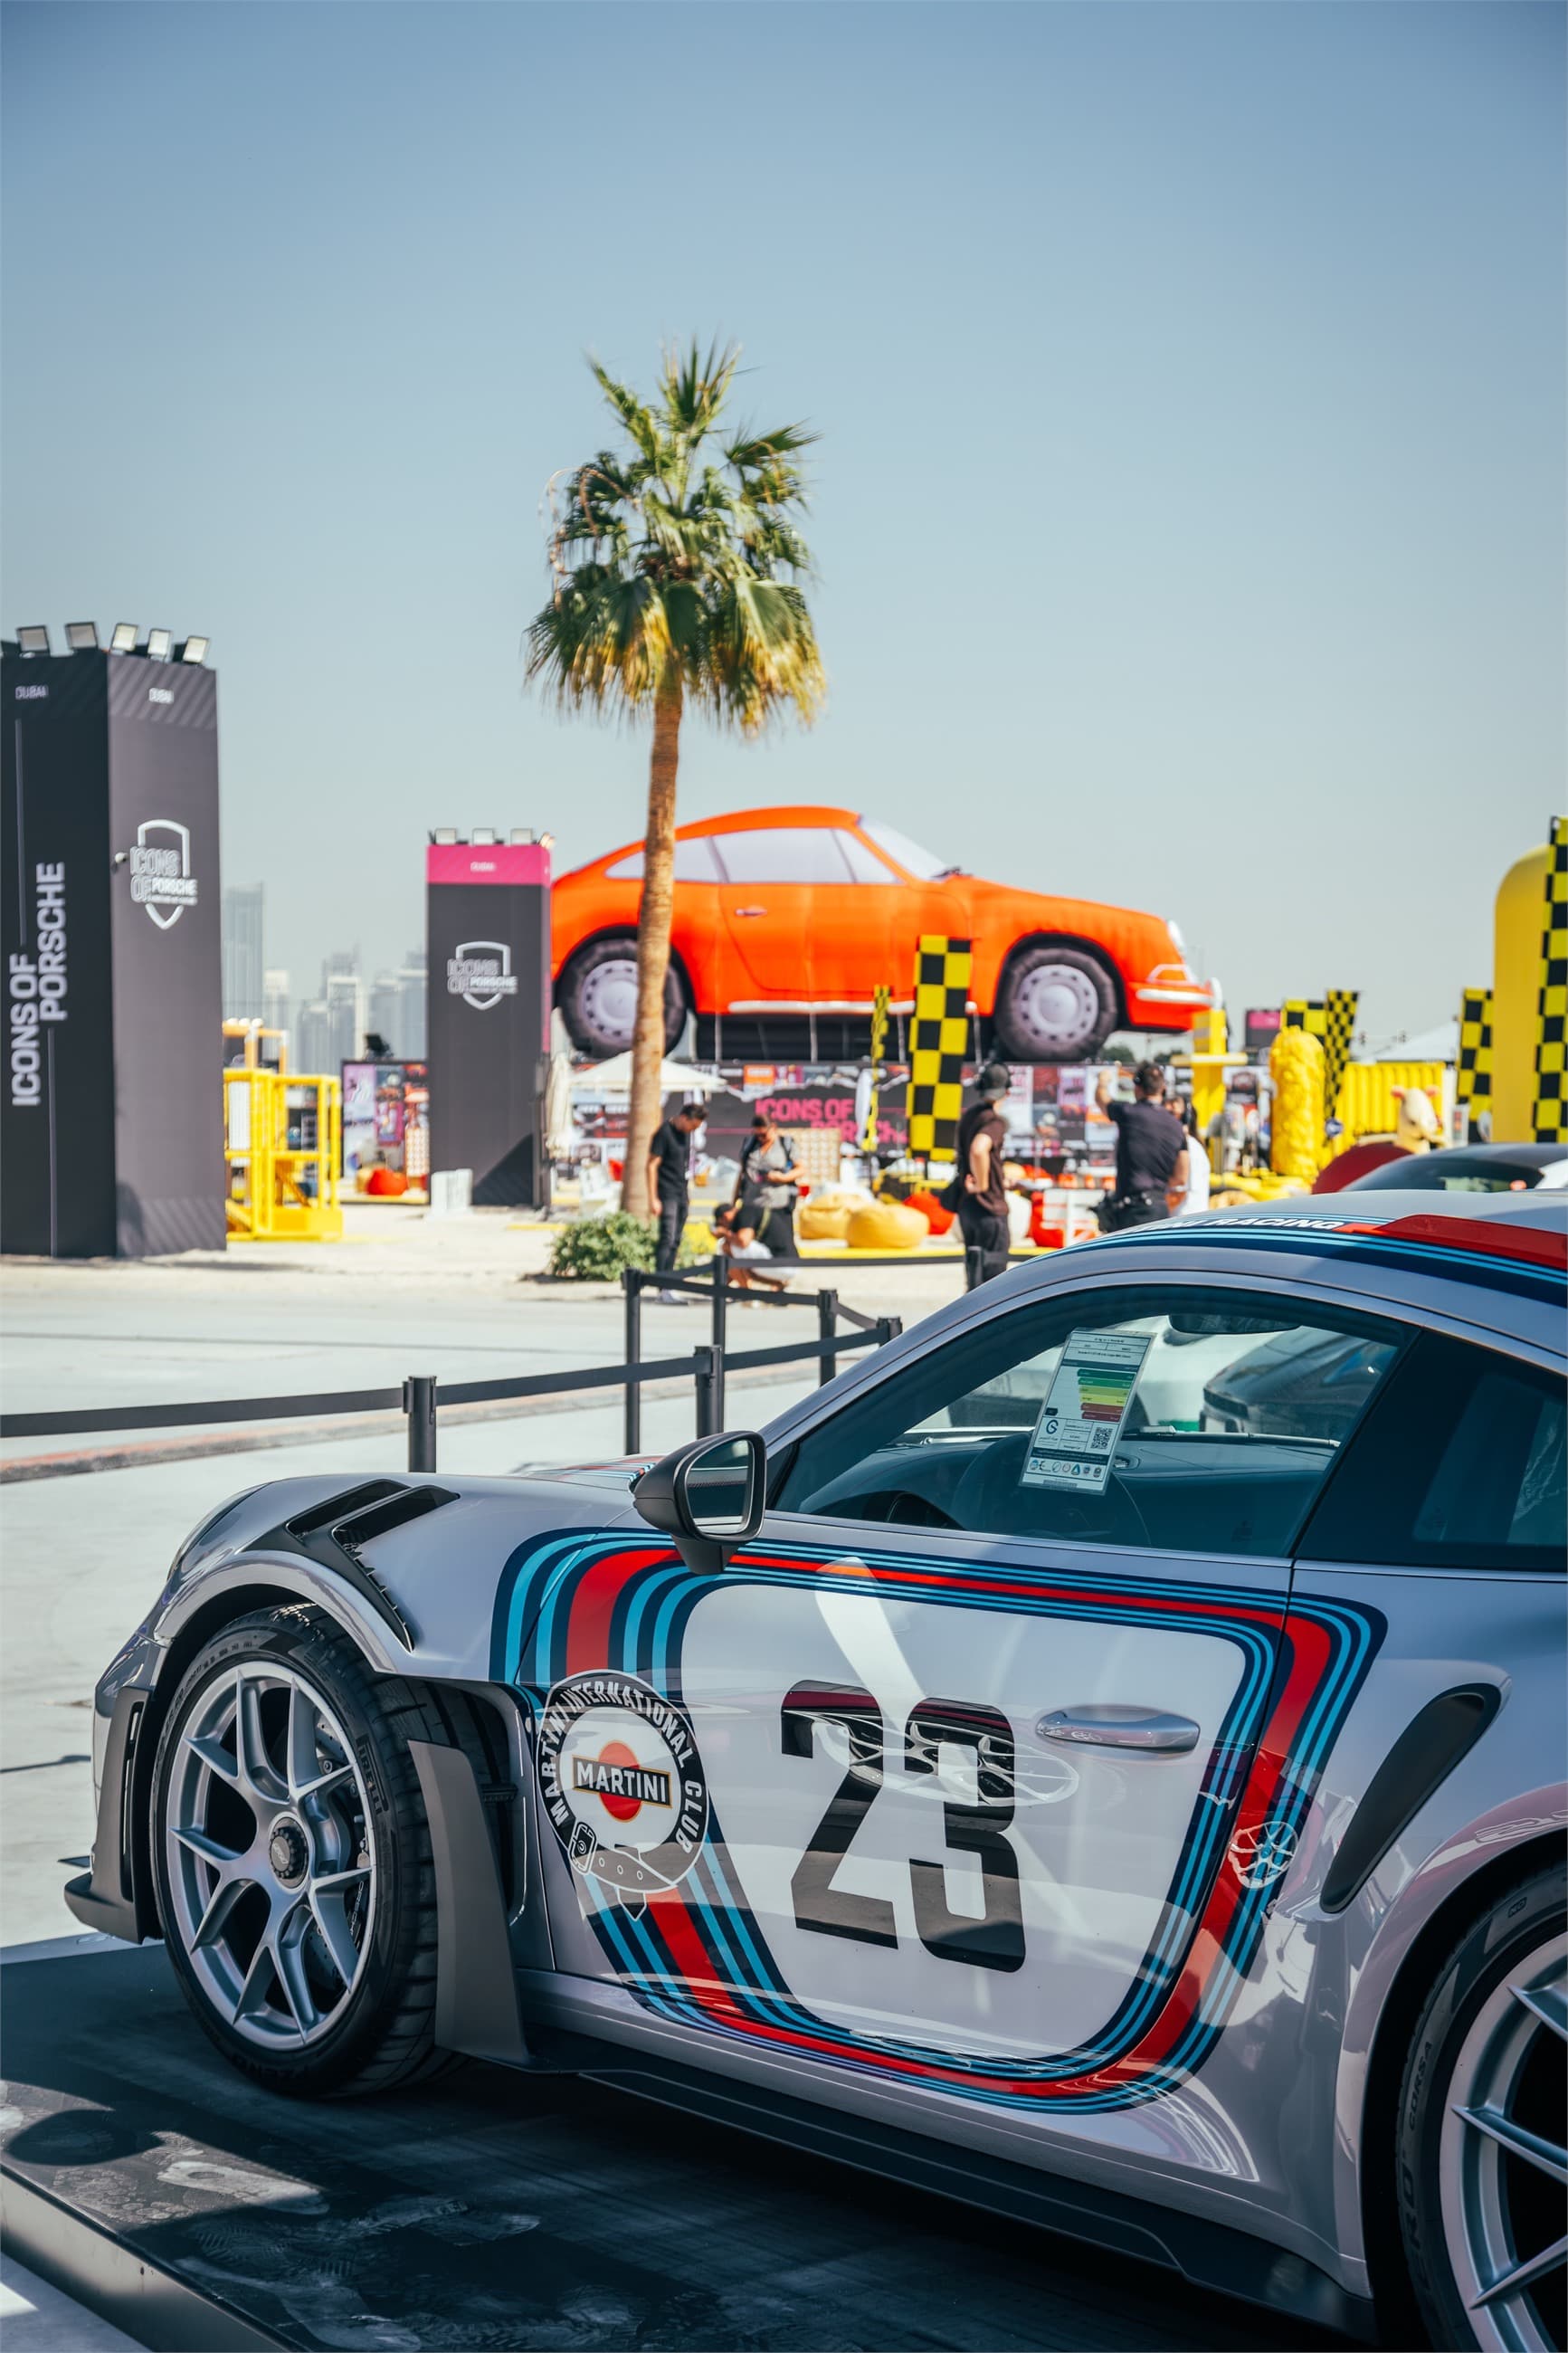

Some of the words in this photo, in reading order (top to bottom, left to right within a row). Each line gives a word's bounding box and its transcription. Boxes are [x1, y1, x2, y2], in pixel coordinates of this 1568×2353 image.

[9, 953, 38, 999] OF
[35, 861, 68, 1022] PORSCHE
[10, 1003, 42, 1106] ICONS
[755, 1098, 824, 1122] ICONS
[824, 1098, 855, 1121] OF
[1203, 1217, 1345, 1230] RACING
[541, 1706, 568, 1827] MARTINI
[560, 1680, 695, 1769] INTERNATIONAL
[675, 1779, 703, 1855] CLUB
[576, 1760, 668, 1804] MARTINI
[781, 1679, 1027, 1974] 23
[1406, 2040, 1433, 2134] CORSA
